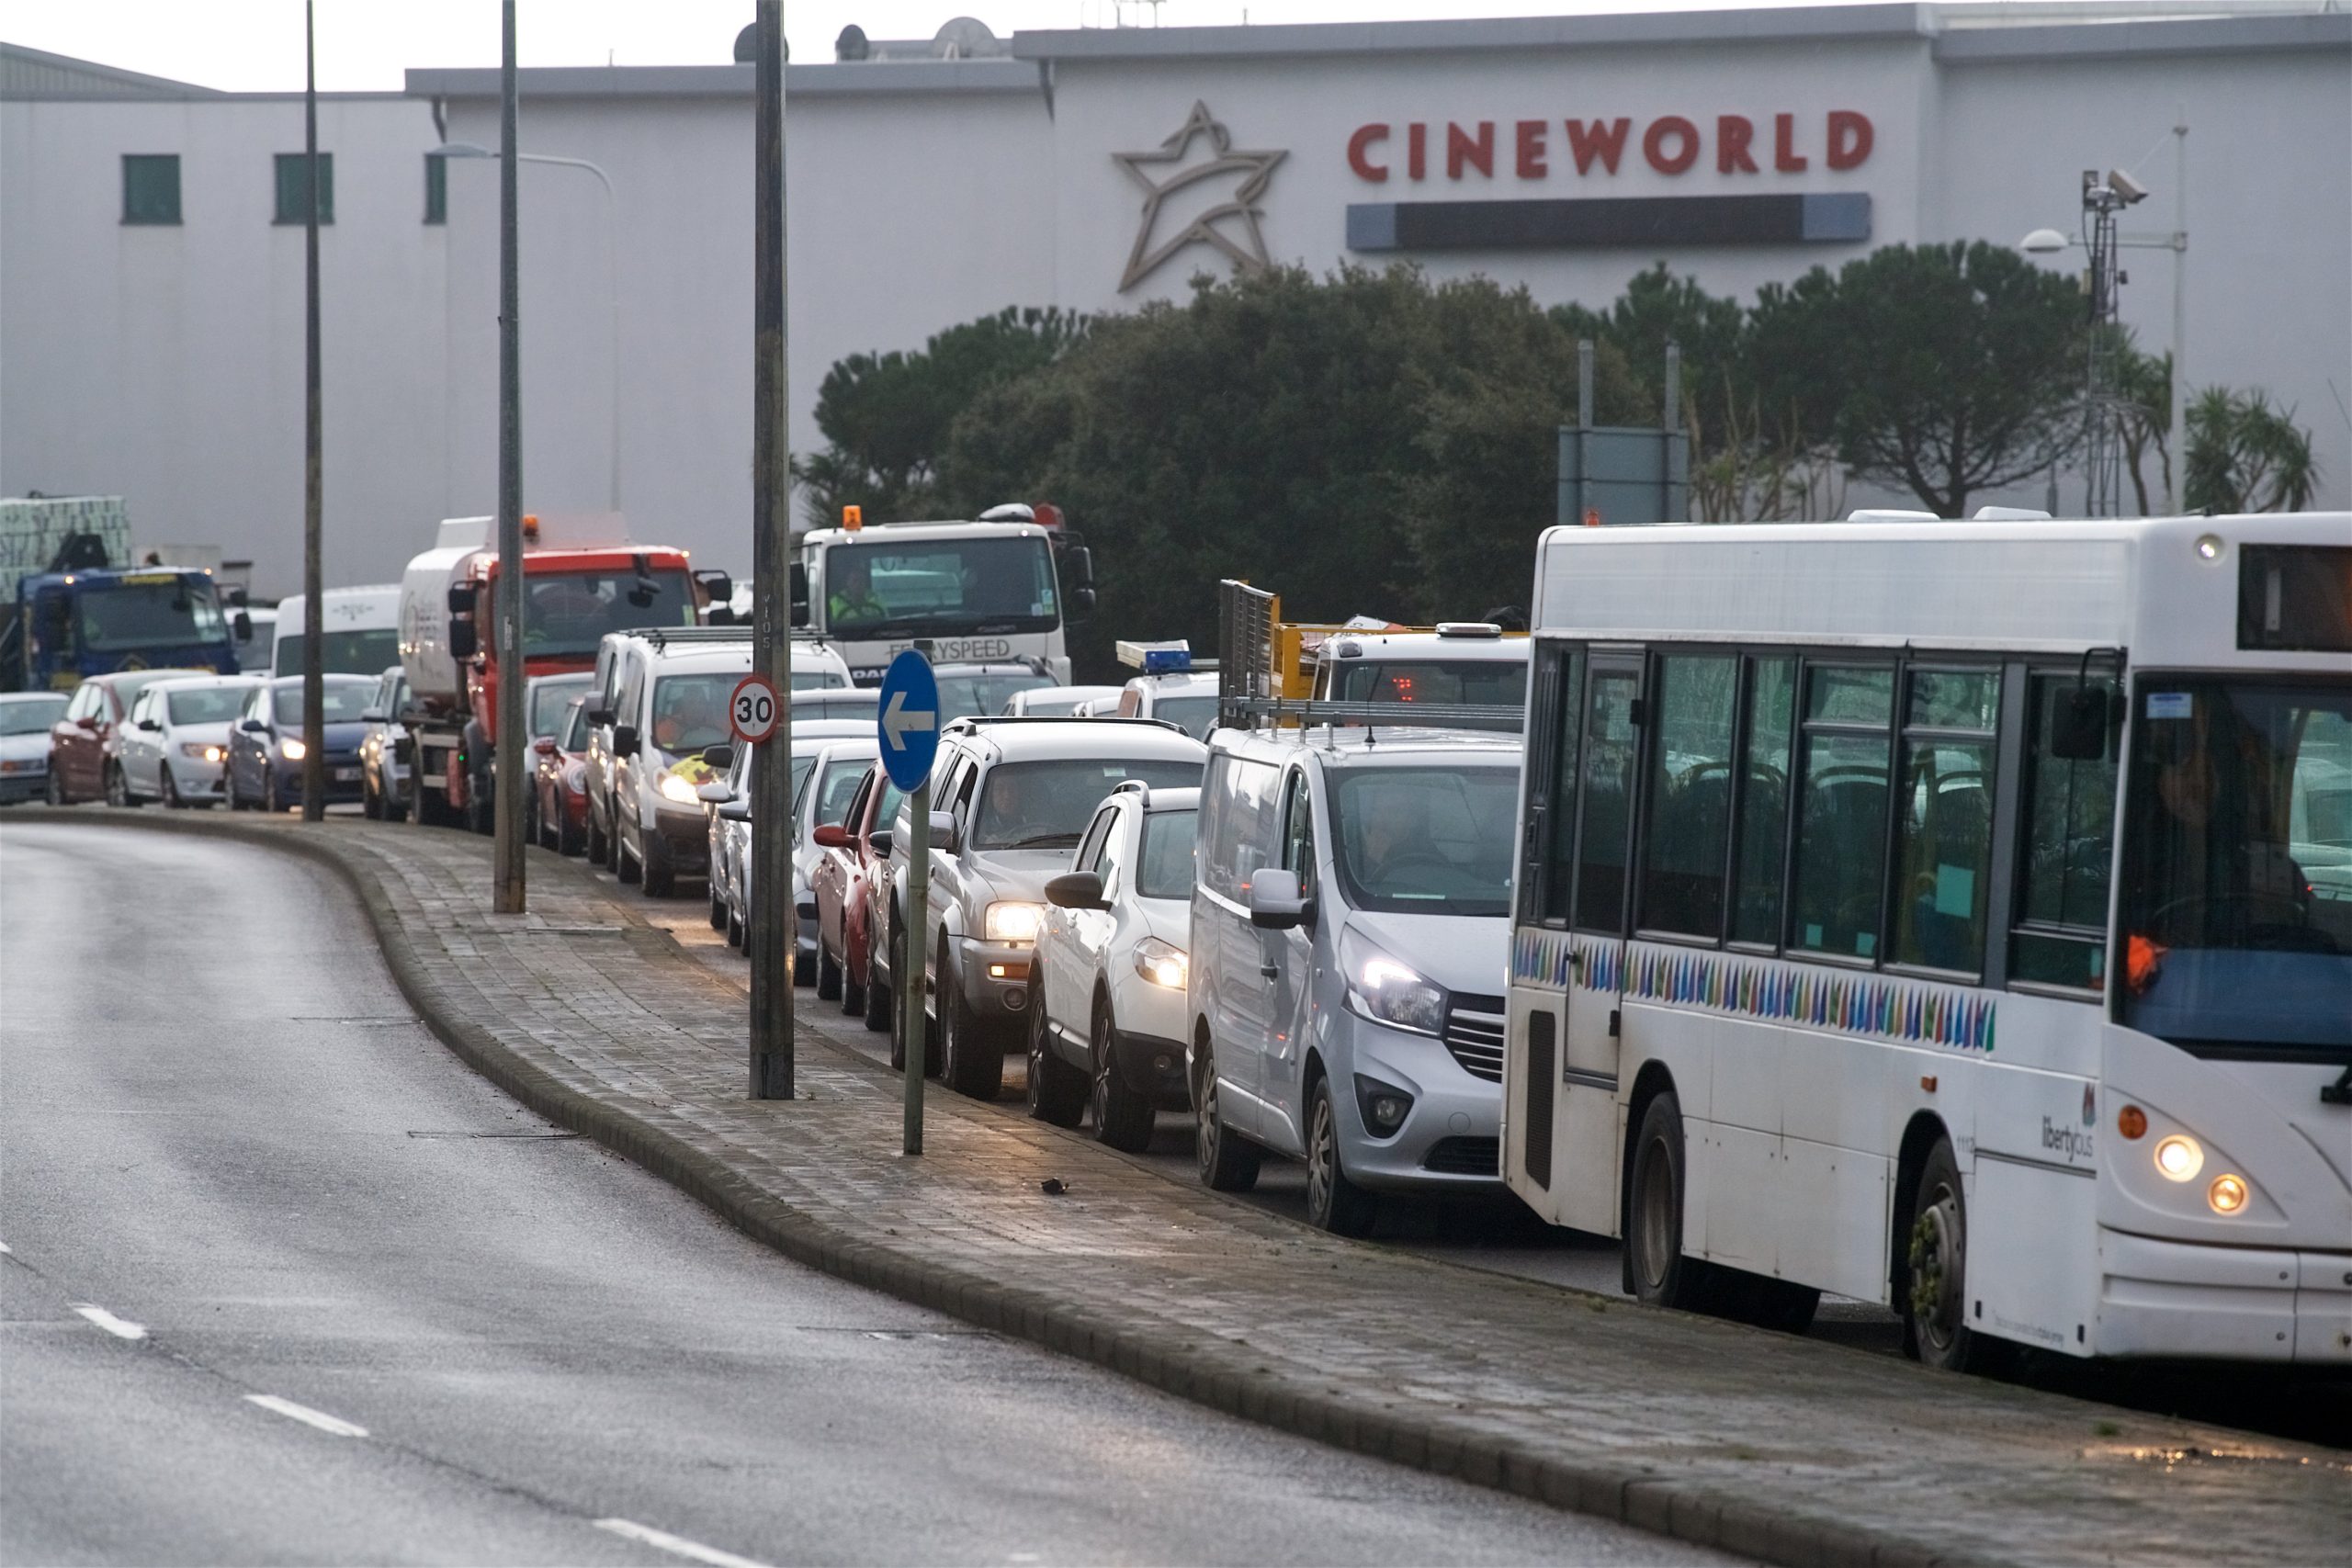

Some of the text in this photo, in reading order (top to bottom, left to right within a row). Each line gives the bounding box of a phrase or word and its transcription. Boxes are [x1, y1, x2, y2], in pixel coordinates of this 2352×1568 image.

[1347, 110, 1874, 182] CINEWORLD
[885, 639, 1011, 660] FYSPEED
[737, 696, 773, 723] 30
